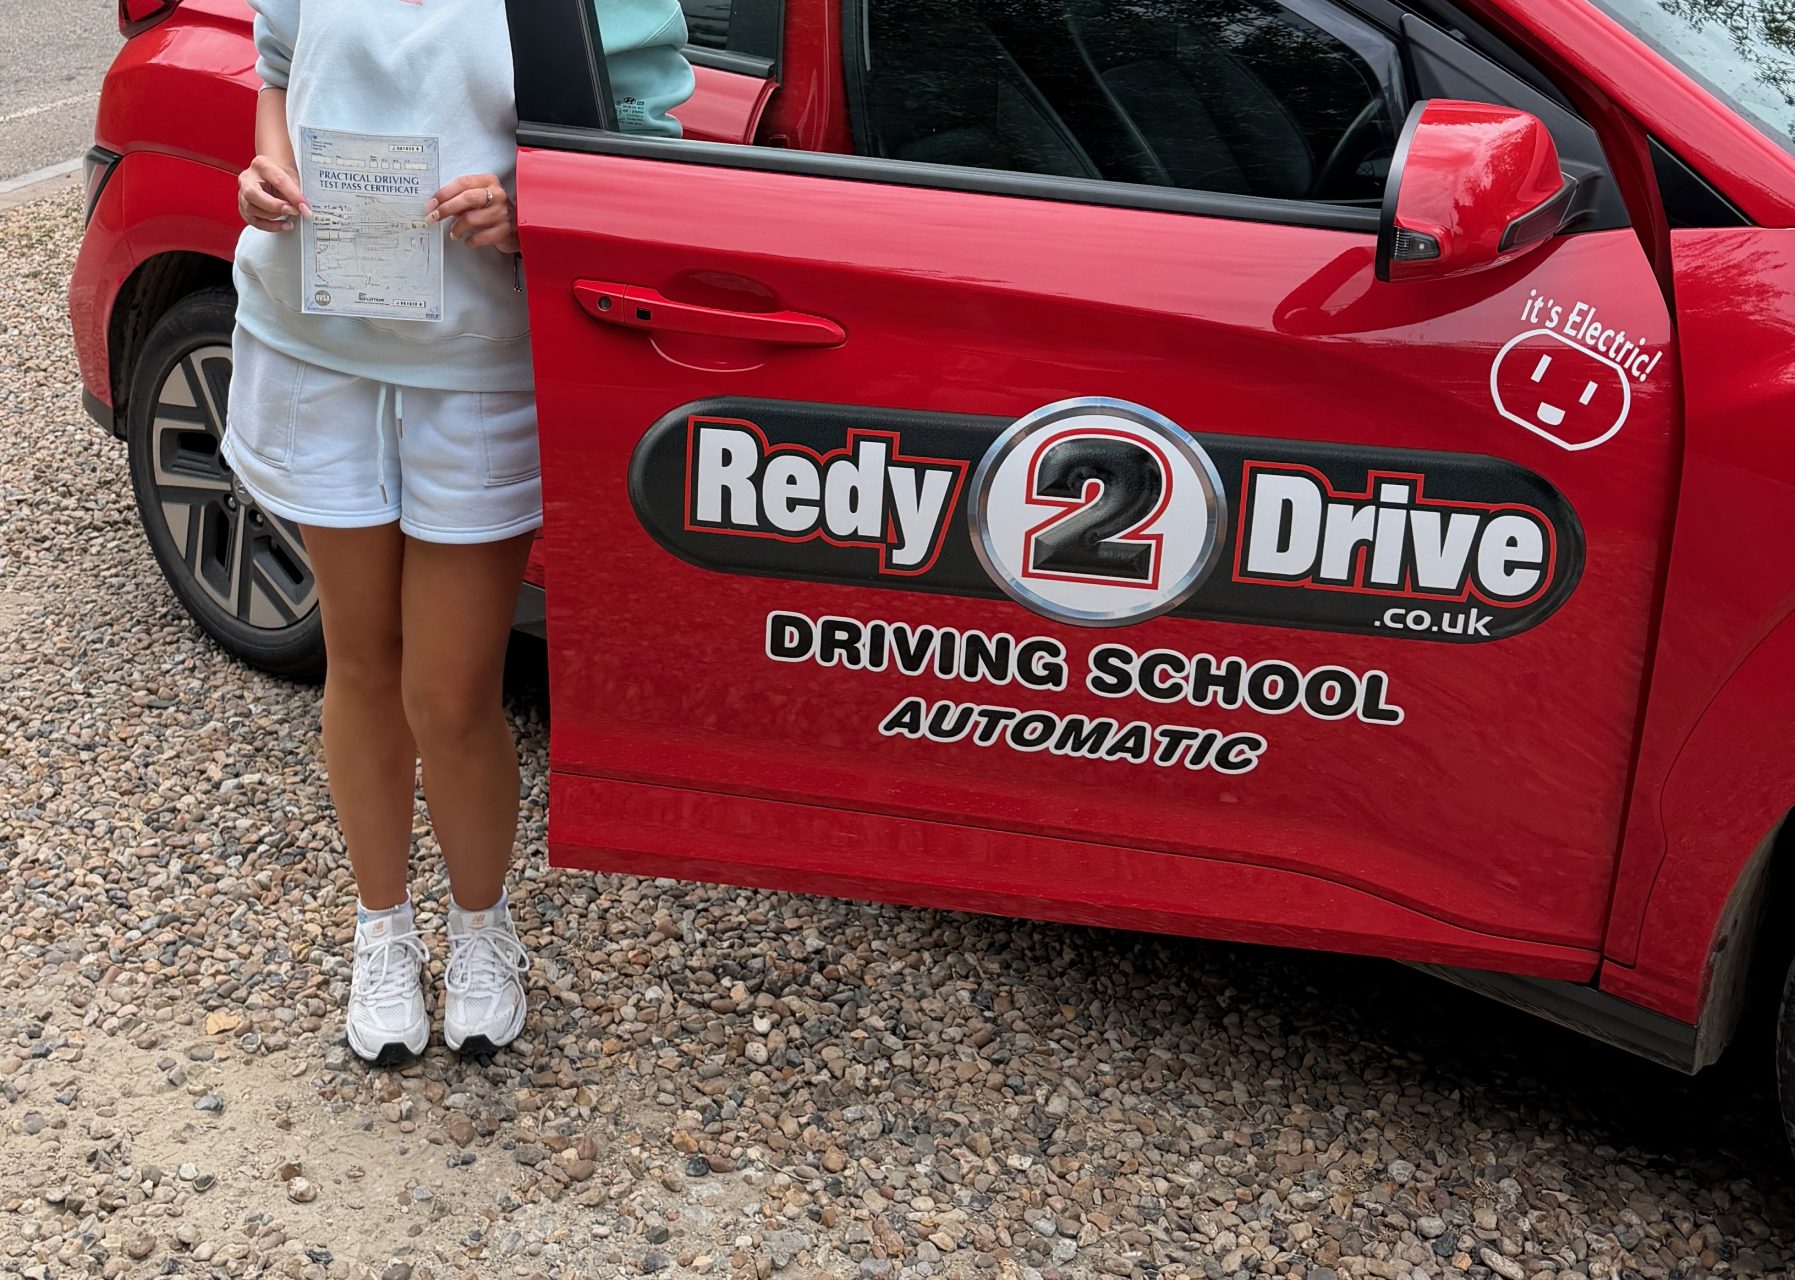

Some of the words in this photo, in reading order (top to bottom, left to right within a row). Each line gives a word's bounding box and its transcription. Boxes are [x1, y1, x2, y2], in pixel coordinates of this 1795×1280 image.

[319, 169, 371, 183] PRACTICAL
[374, 175, 419, 185] DRIVING
[320, 180, 339, 189] TEST
[341, 182, 361, 191] PASS
[364, 183, 419, 194] CERTIFICATE
[1520, 288, 1563, 328] it's
[1563, 301, 1663, 382] Electric!
[694, 425, 955, 568] Redy
[1026, 431, 1167, 586] 2
[1244, 472, 1545, 598] Drive
[1373, 607, 1494, 637] .co.uk
[766, 610, 1069, 692] DRIVING
[1085, 644, 1405, 726] SCHOOL
[879, 697, 1268, 775] AUTOMATIC
